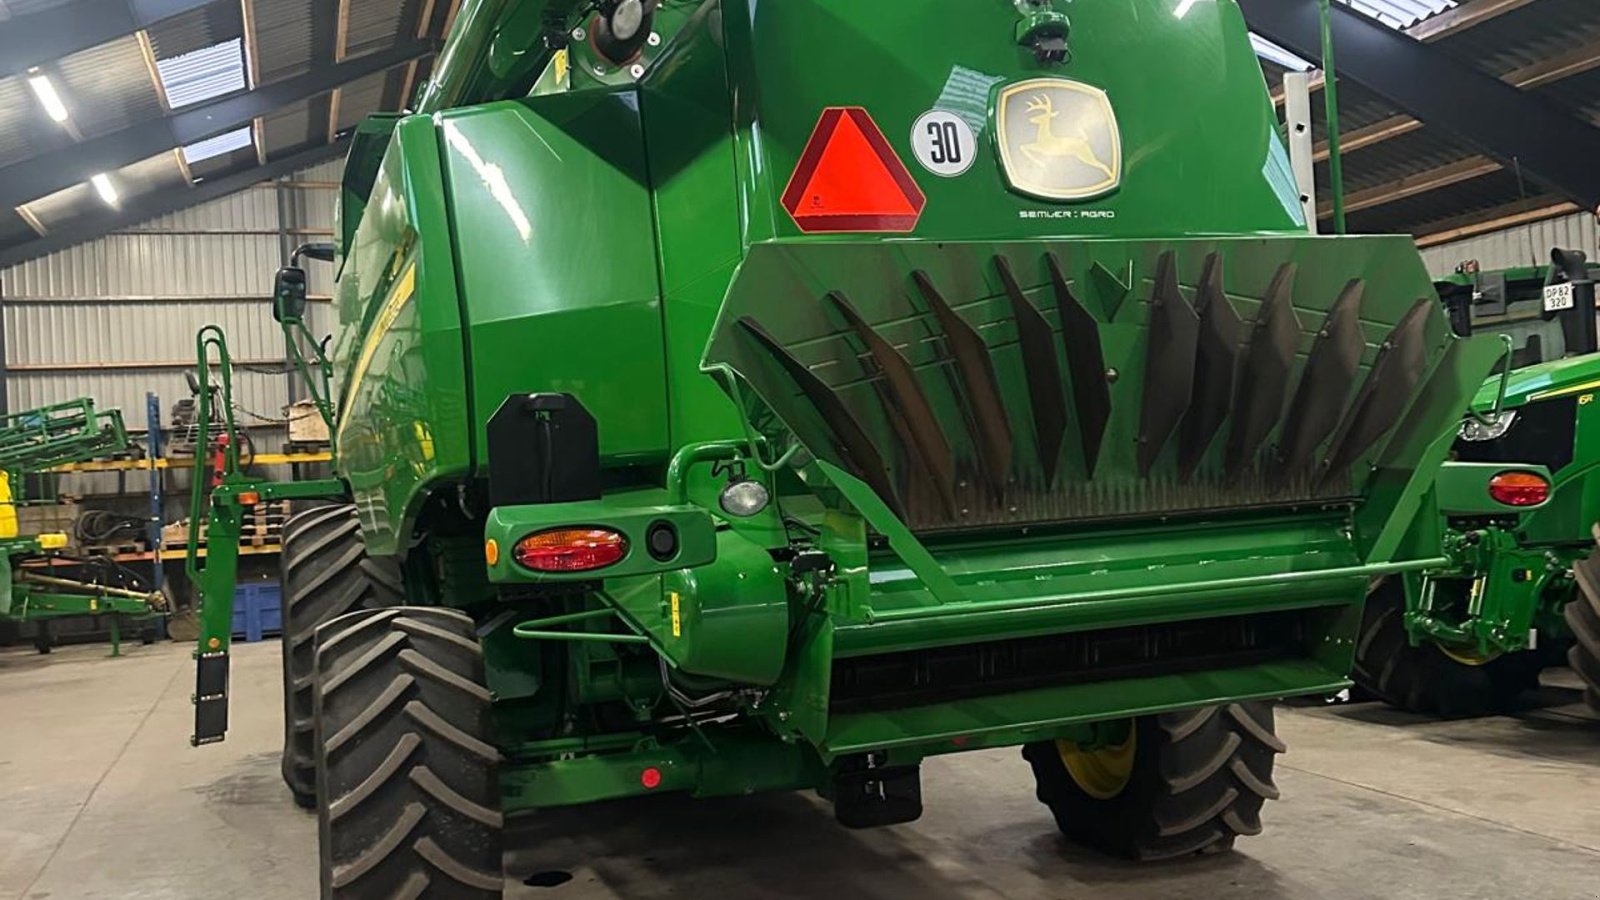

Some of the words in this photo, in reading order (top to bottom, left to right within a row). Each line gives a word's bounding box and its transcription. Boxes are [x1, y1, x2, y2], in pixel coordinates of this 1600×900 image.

[927, 121, 962, 164] 30
[1080, 211, 1115, 219] AGRO
[1550, 296, 1567, 308] 320
